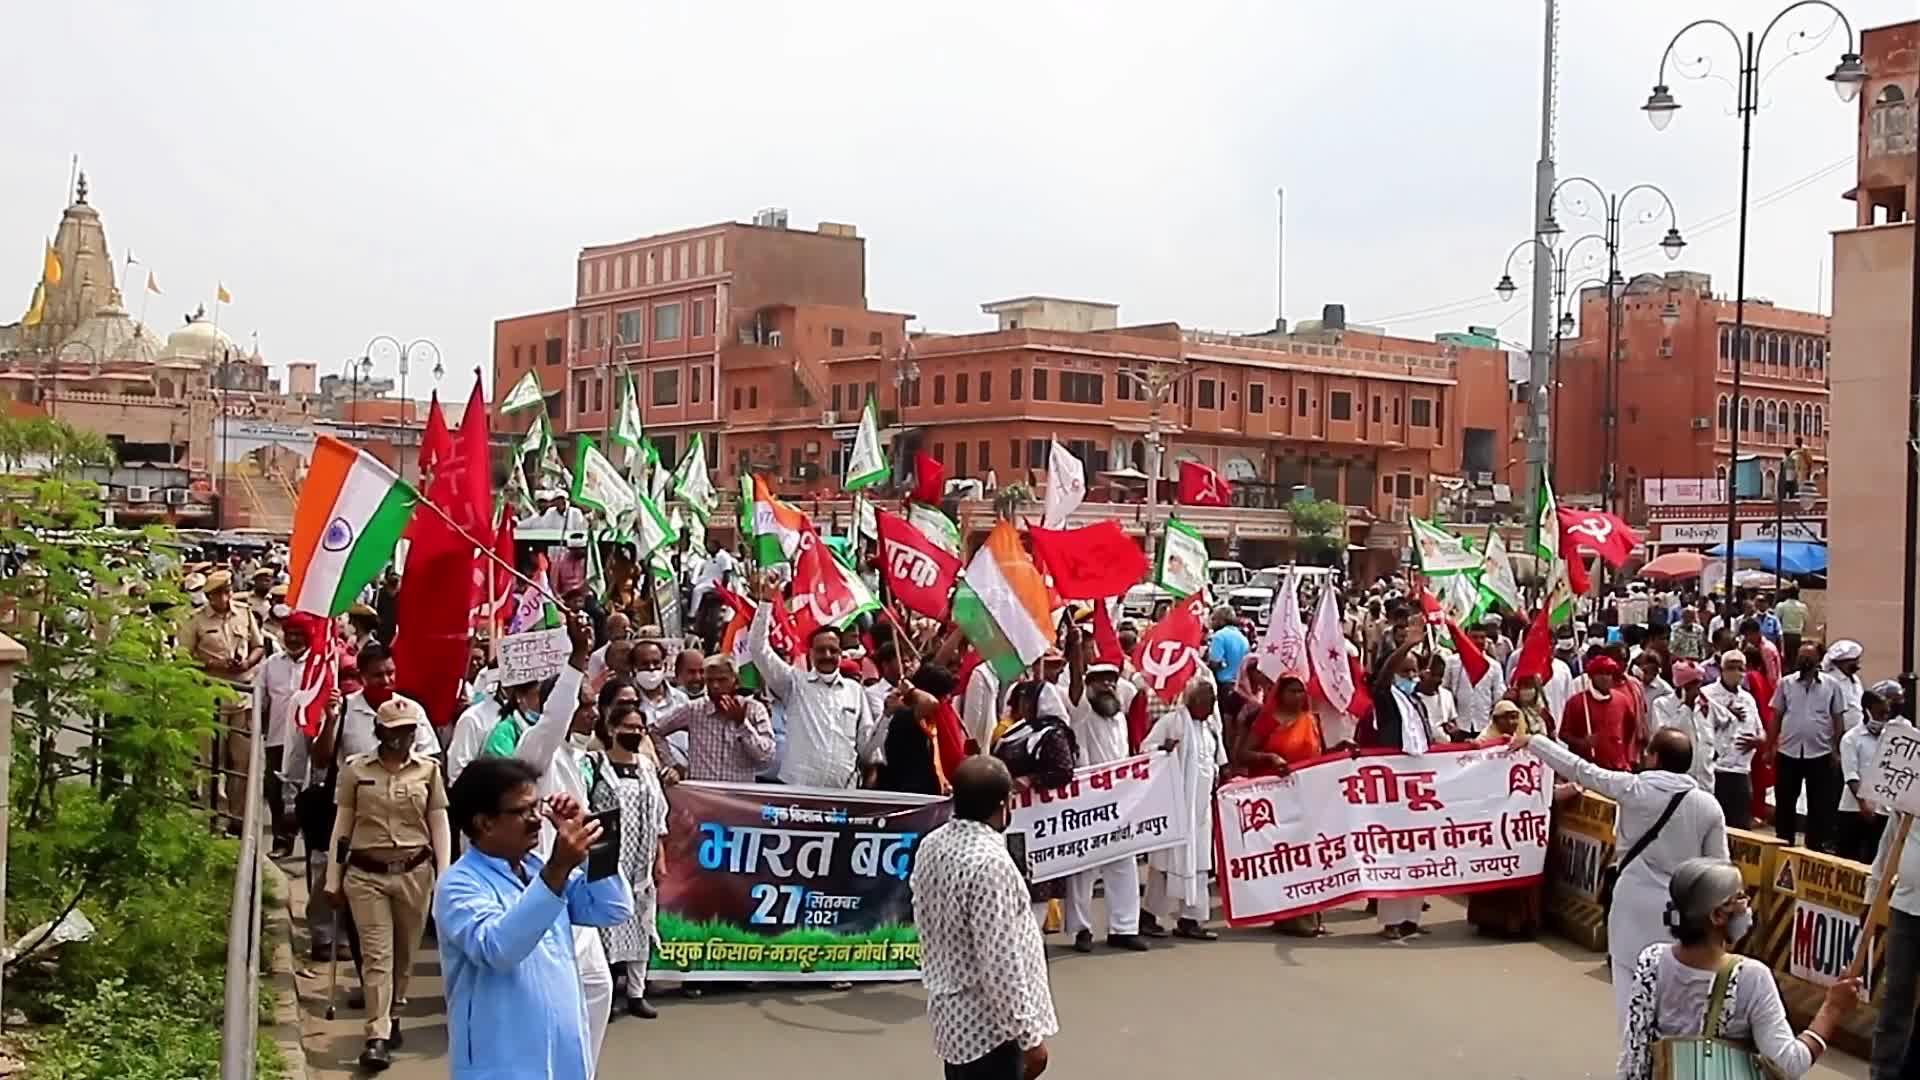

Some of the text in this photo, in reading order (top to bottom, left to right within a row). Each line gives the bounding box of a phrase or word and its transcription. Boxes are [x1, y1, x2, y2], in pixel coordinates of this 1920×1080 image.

[1339, 765, 1445, 811] सीटू
[1034, 802, 1120, 839] 27 सितम्बर
[1090, 831, 1108, 849] जन
[698, 823, 840, 879] भारत
[1230, 842, 1313, 881] भारतीय
[1315, 833, 1346, 870] ट्रेड
[1350, 824, 1436, 864] यूनियन
[1440, 817, 1494, 849] केन्द्र
[1283, 867, 1361, 899] राजस्थान
[1364, 866, 1401, 882] राज्य
[1469, 855, 1520, 876] जयपुर
[750, 884, 862, 925] 27 सितम्बर
[804, 910, 839, 926] 2021
[659, 938, 704, 968] संयुक्त
[853, 938, 888, 962] मोर्चा
